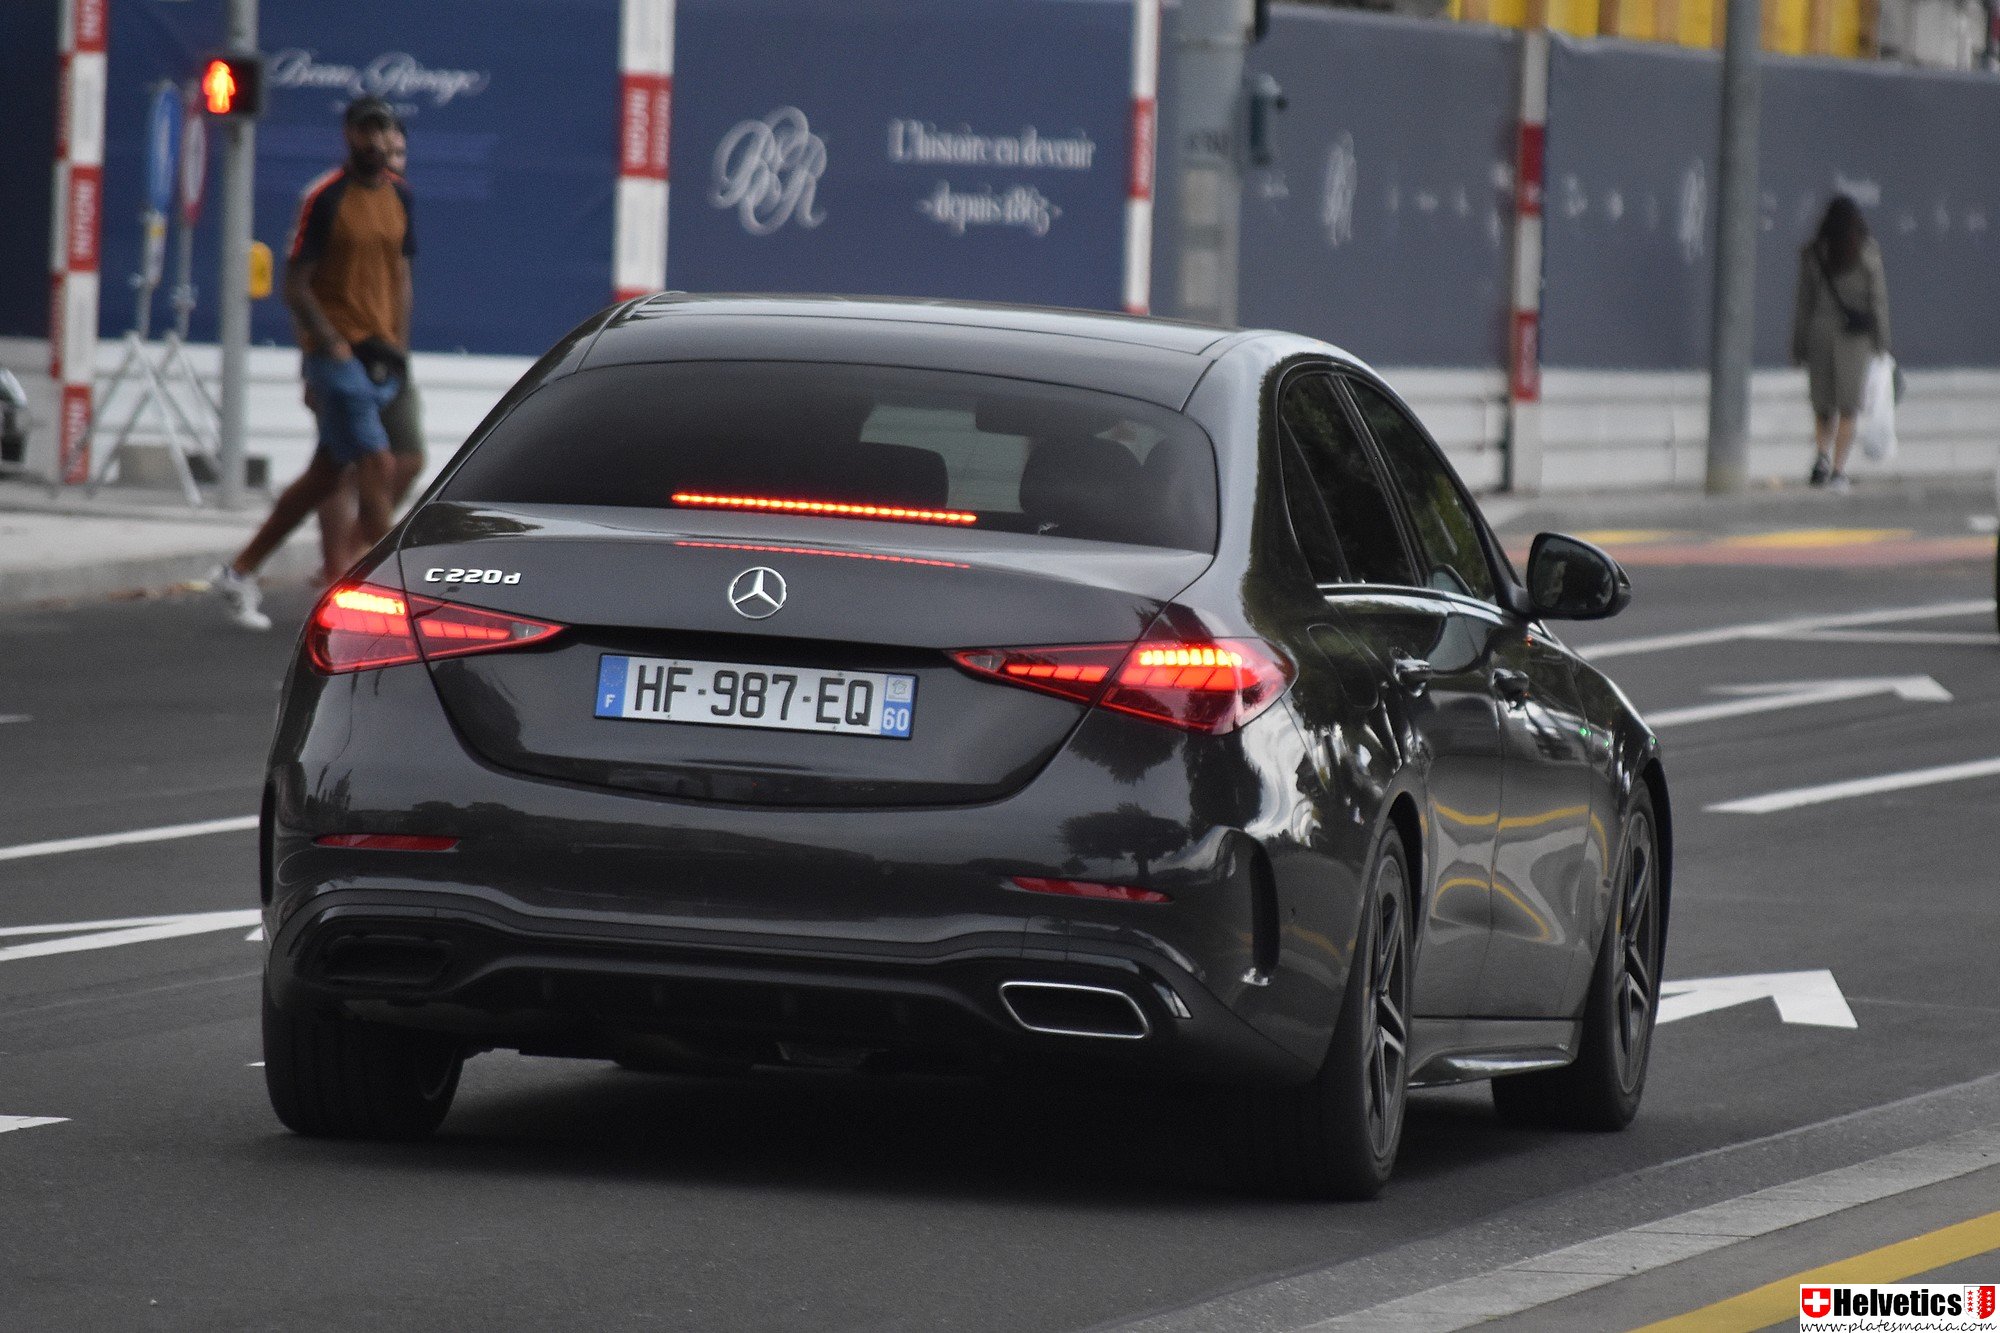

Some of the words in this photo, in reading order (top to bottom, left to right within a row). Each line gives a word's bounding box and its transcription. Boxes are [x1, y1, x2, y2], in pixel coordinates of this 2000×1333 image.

[604, 693, 616, 708] F
[635, 664, 874, 727] HF-987-EQ
[882, 707, 910, 731] 60
